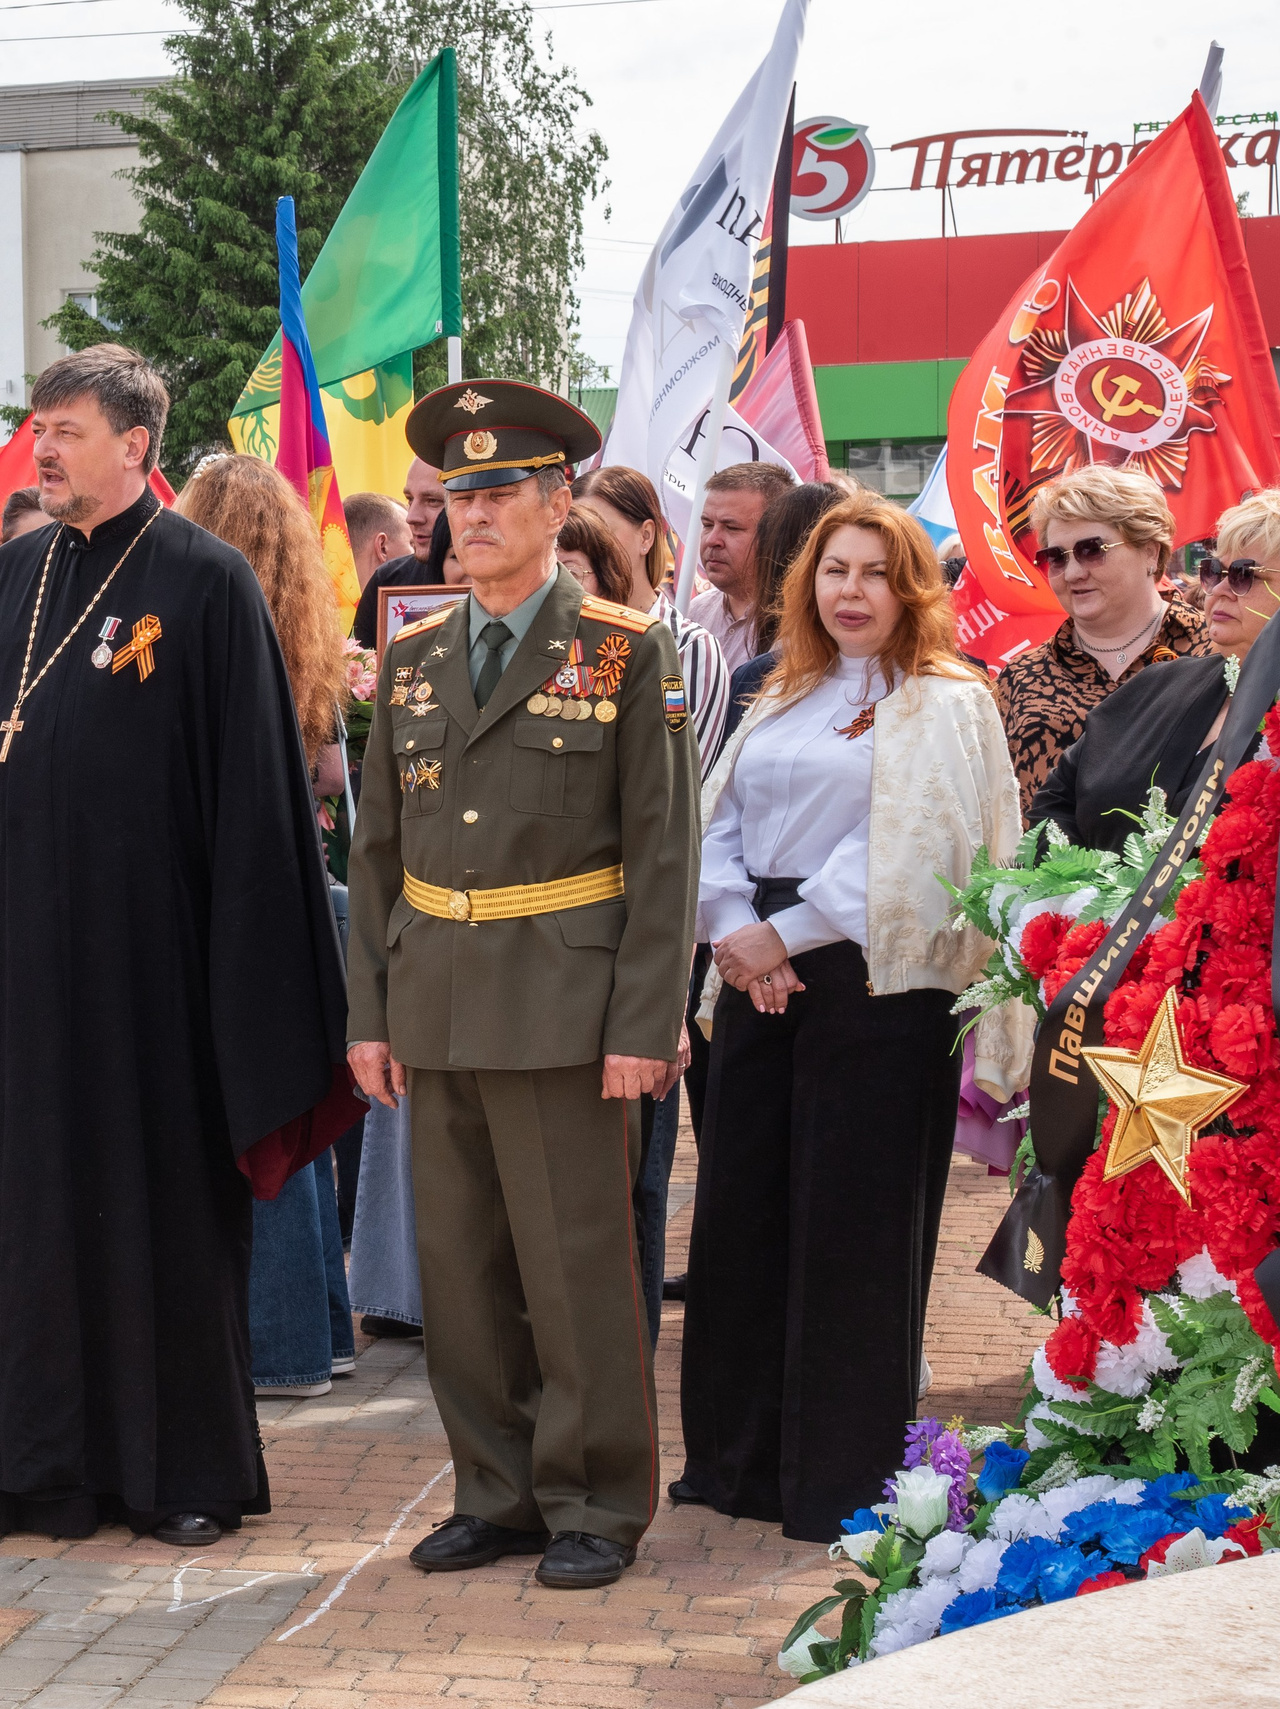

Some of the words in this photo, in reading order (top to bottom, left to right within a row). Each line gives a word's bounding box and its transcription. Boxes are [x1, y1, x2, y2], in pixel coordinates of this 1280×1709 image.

[890, 128, 1280, 196] Пятёрка
[1048, 917, 1141, 1085] Павшим
[1142, 758, 1225, 908] героям
